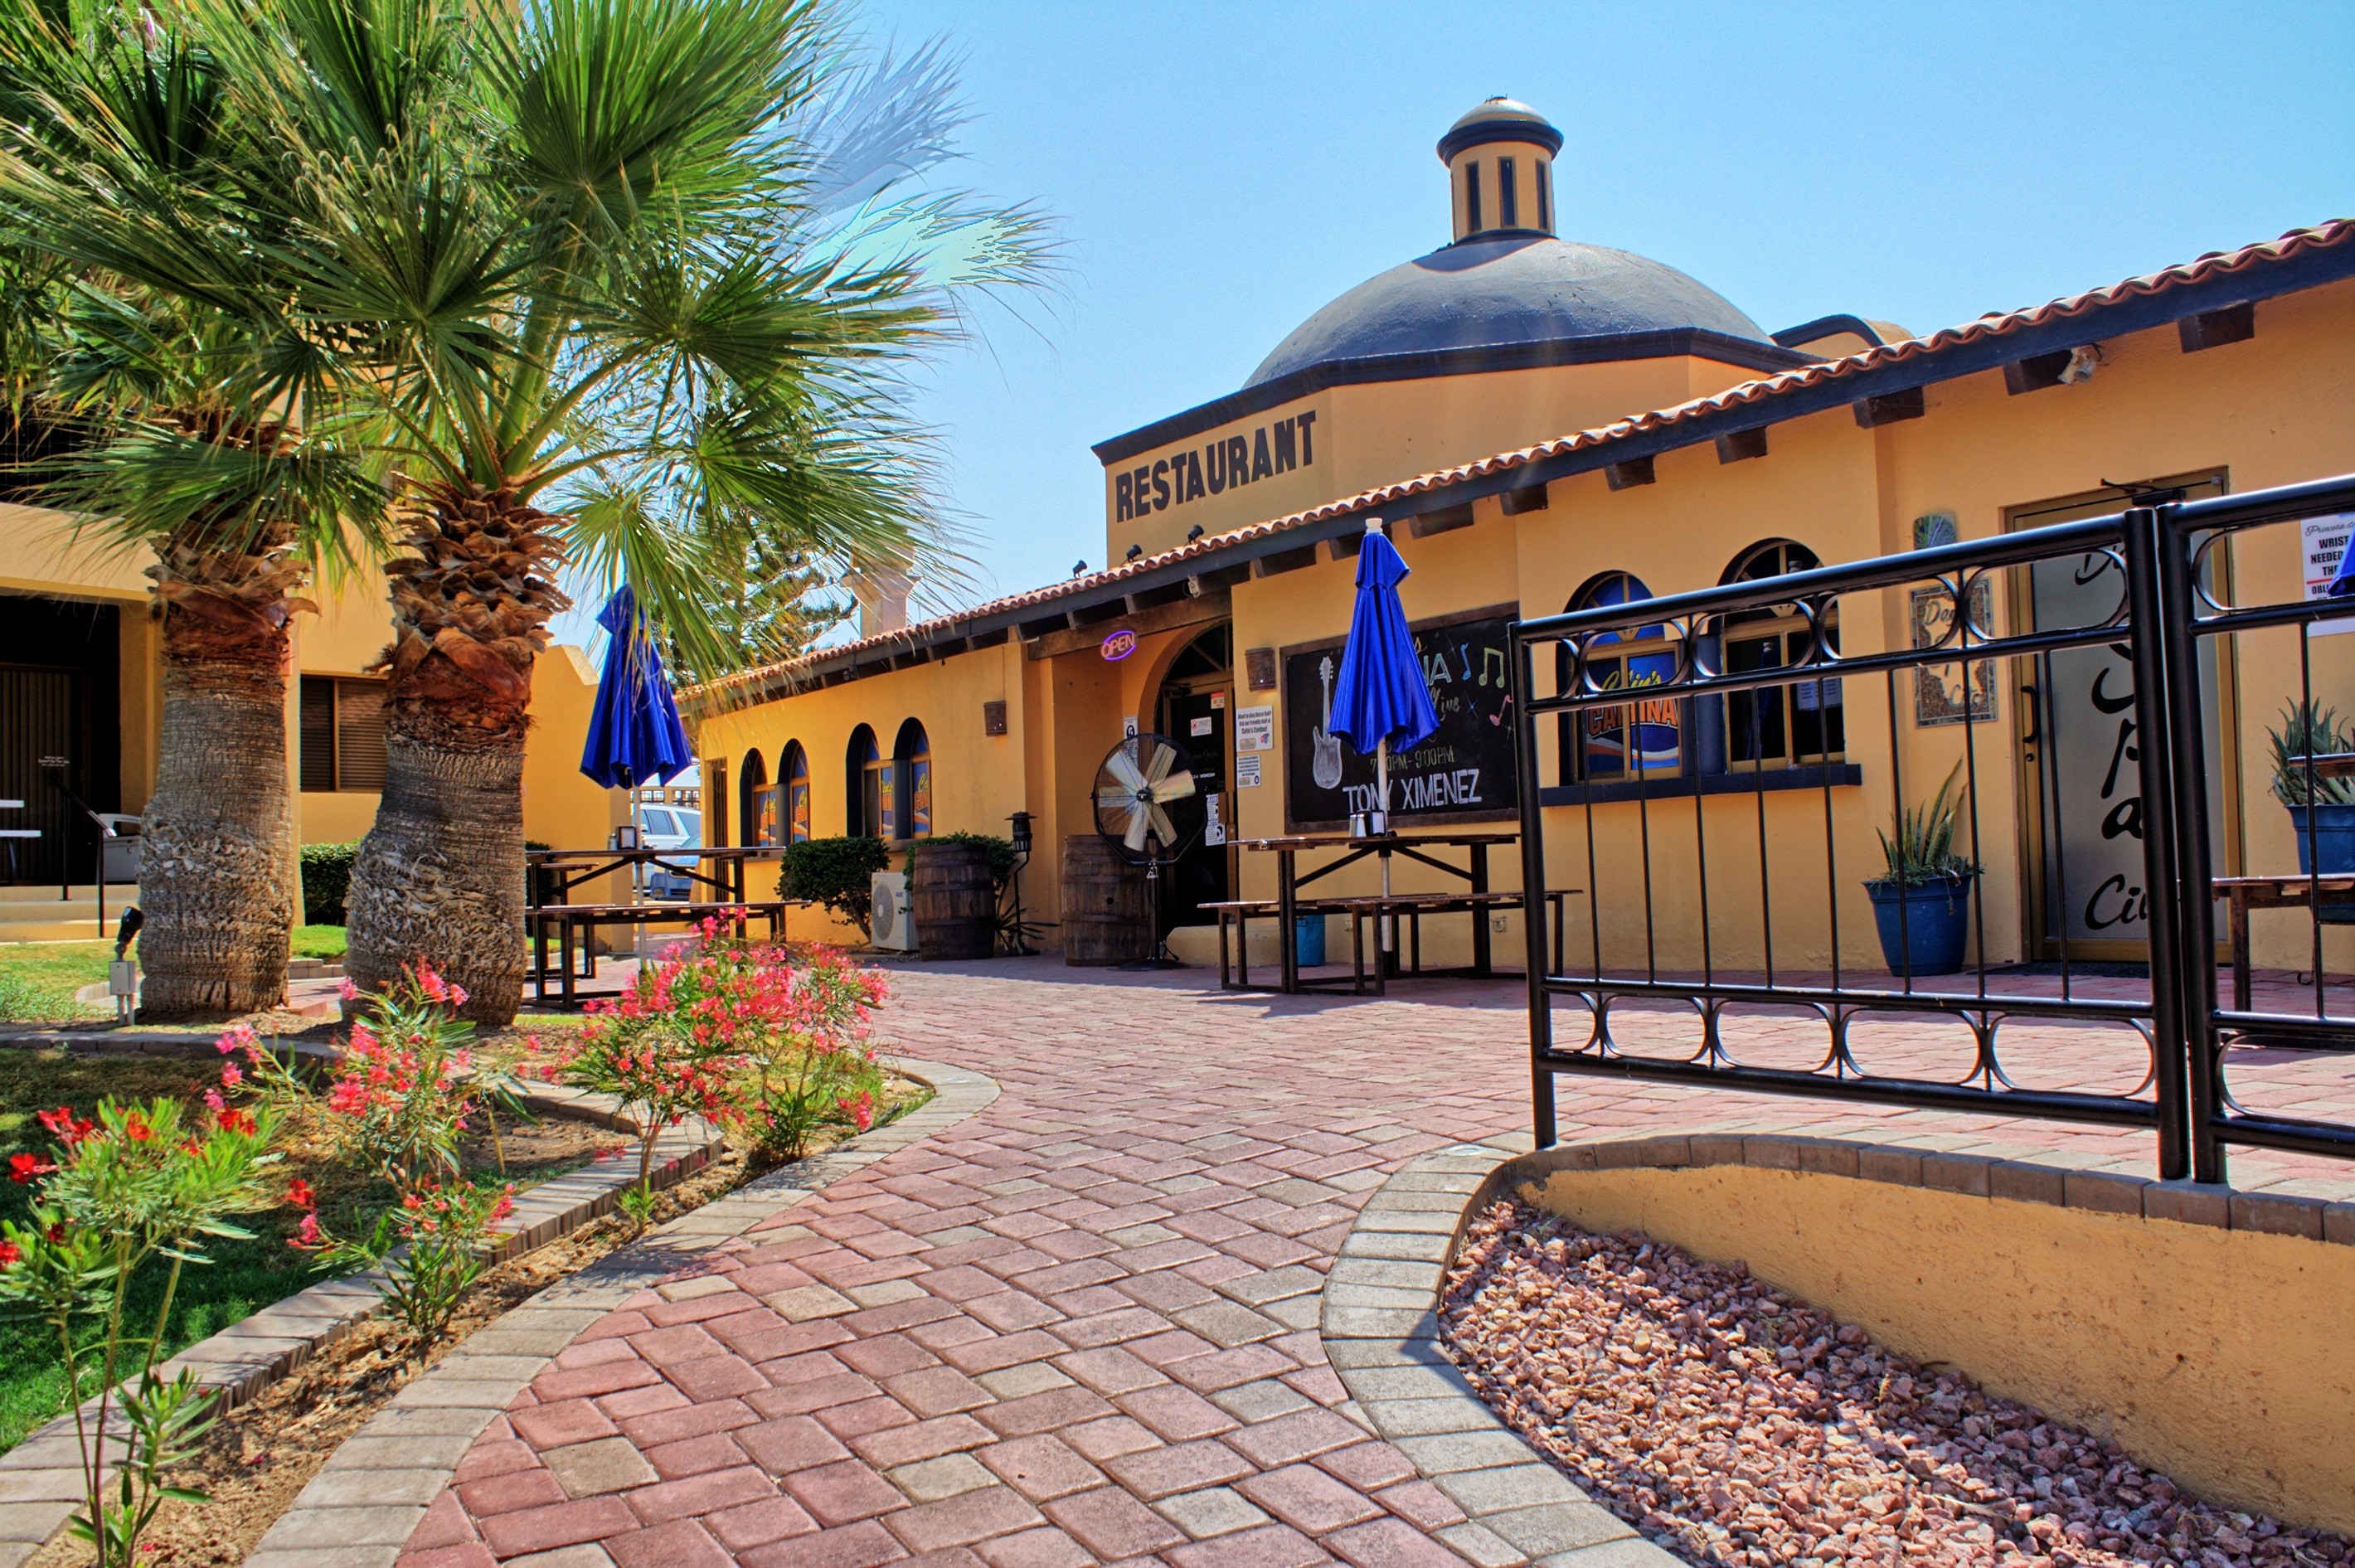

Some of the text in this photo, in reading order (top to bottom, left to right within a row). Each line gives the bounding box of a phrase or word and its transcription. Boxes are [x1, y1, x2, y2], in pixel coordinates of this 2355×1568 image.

[1116, 410, 1316, 523] RESTAURANT
[2319, 536, 2349, 549] WRIST
[1101, 633, 1134, 658] OPEN
[1343, 769, 1483, 813] TONY XIMENEZ
